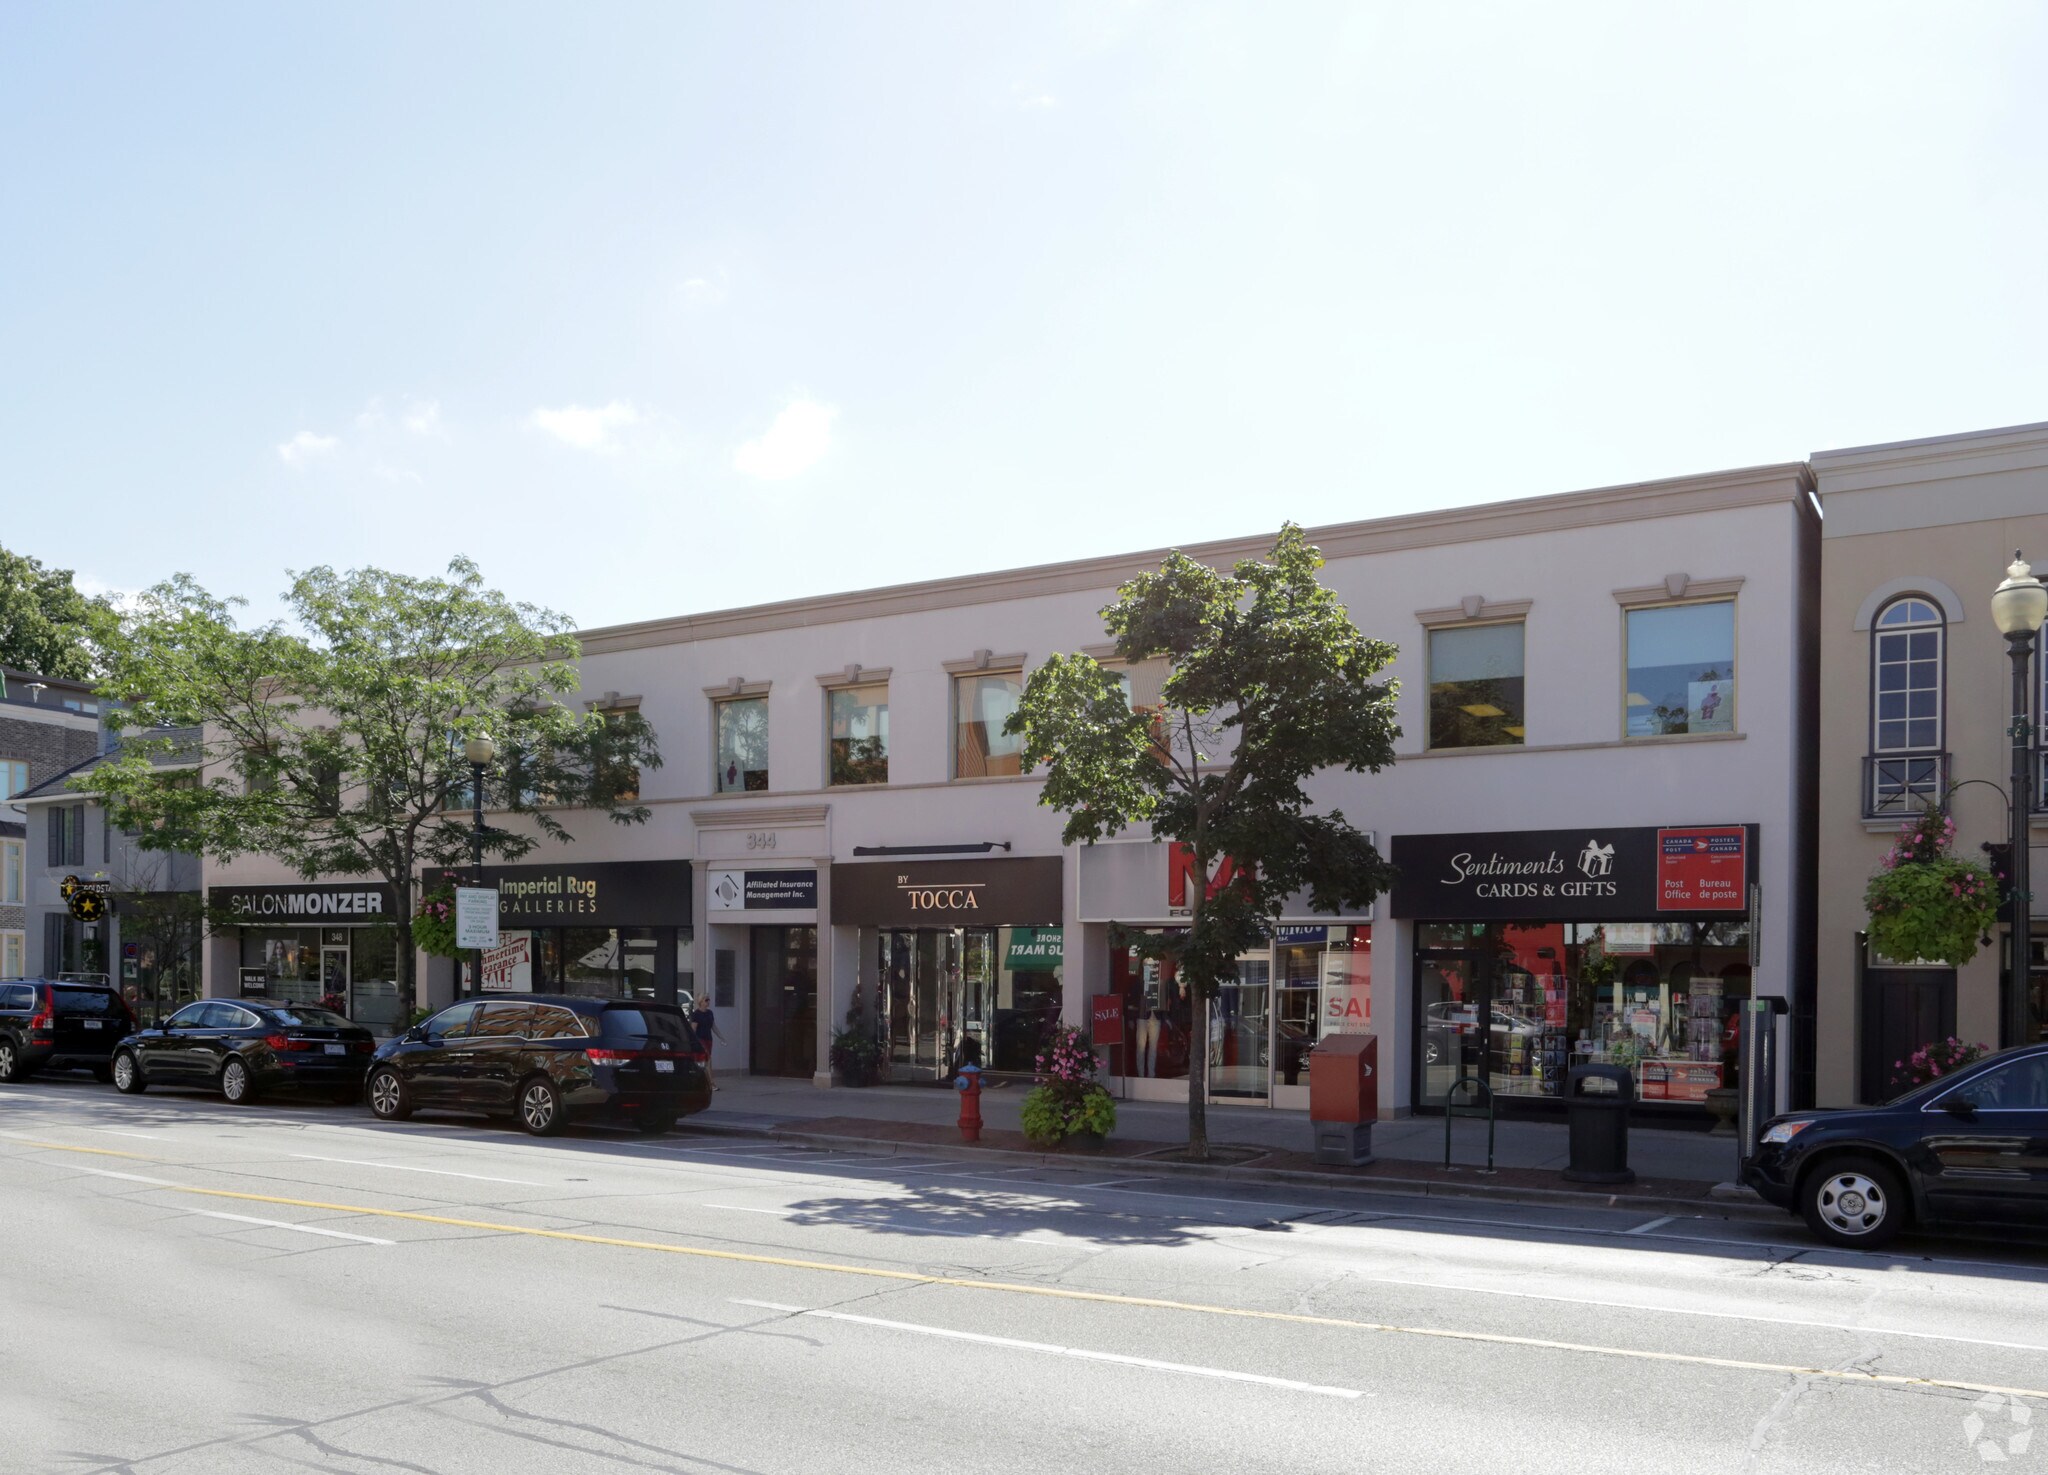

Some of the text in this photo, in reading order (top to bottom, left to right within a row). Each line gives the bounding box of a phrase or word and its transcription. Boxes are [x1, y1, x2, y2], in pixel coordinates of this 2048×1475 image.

[746, 832, 776, 850] 344
[1440, 850, 1564, 884] Sentiments
[746, 881, 778, 889] Affiliated
[897, 875, 909, 884] BY
[1665, 879, 1684, 888] Post
[1699, 878, 1731, 888] Bureau
[499, 875, 597, 899] Imperial Rug
[1476, 881, 1617, 897] CARDS & GIFTS
[746, 891, 791, 900] Management
[907, 890, 979, 910] TOCCA
[1664, 890, 1691, 899] Office
[1699, 889, 1738, 900] de poste
[499, 899, 597, 913] GALLERIES
[1170, 909, 1193, 917] FO
[481, 942, 525, 965] mmertime
[481, 964, 512, 989] SALE
[1094, 1008, 1119, 1022] SALE
